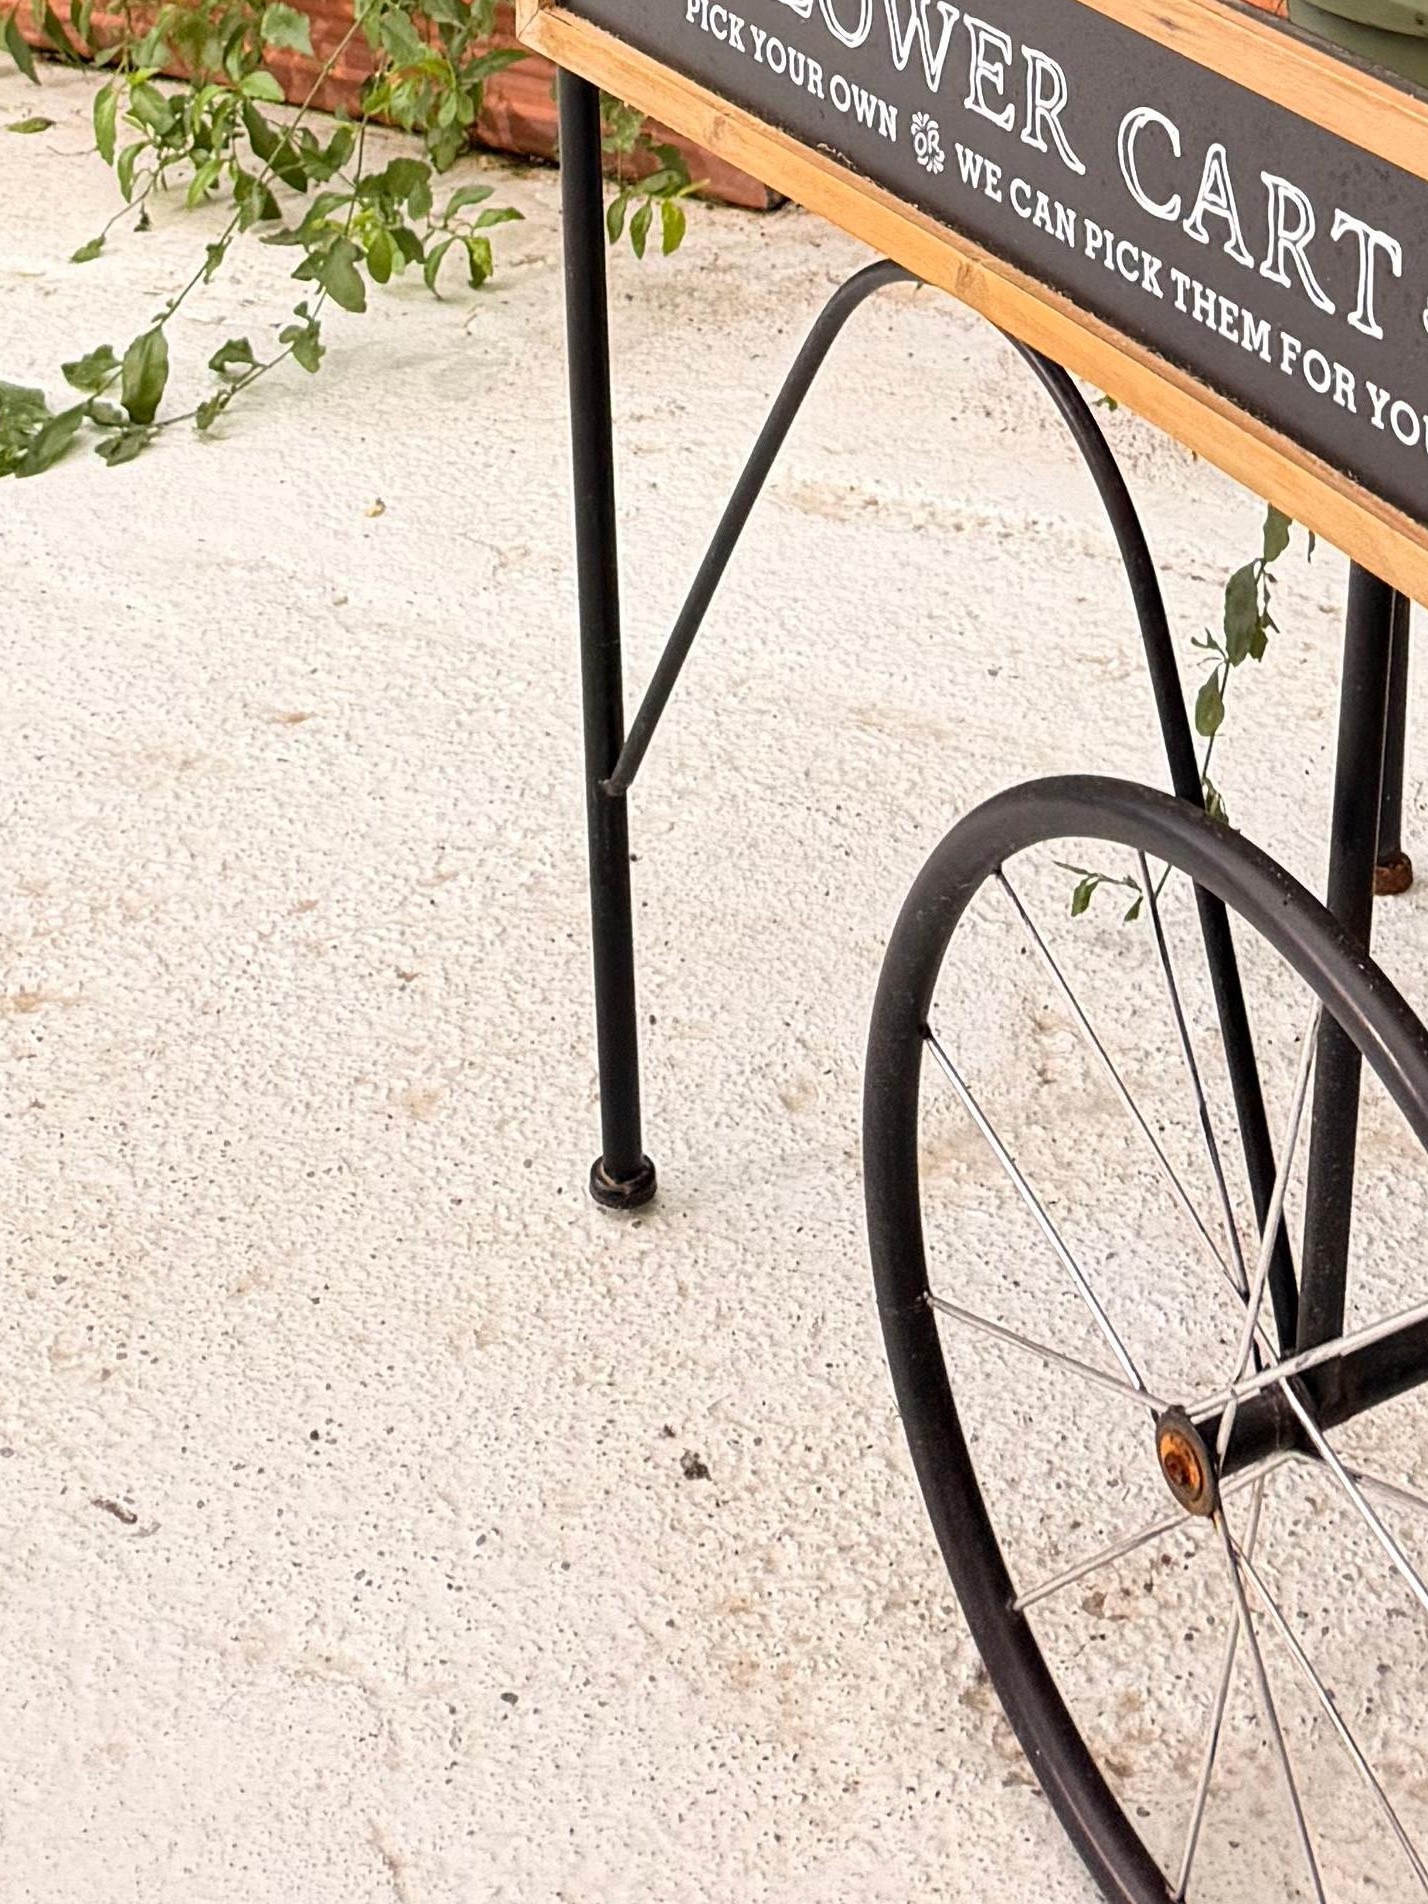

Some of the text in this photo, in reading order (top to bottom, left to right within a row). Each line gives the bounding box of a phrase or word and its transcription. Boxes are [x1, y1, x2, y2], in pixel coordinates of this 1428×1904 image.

[749, 24, 825, 100] YOUR
[829, 74, 898, 143] OWN
[913, 129, 942, 157] OR
[954, 142, 1003, 203] WE
[1009, 177, 1077, 249] CAN
[1083, 218, 1164, 299] PICK
[1170, 267, 1272, 363] THEM
[1280, 331, 1357, 414] FOR
[1117, 106, 1403, 340] CART
